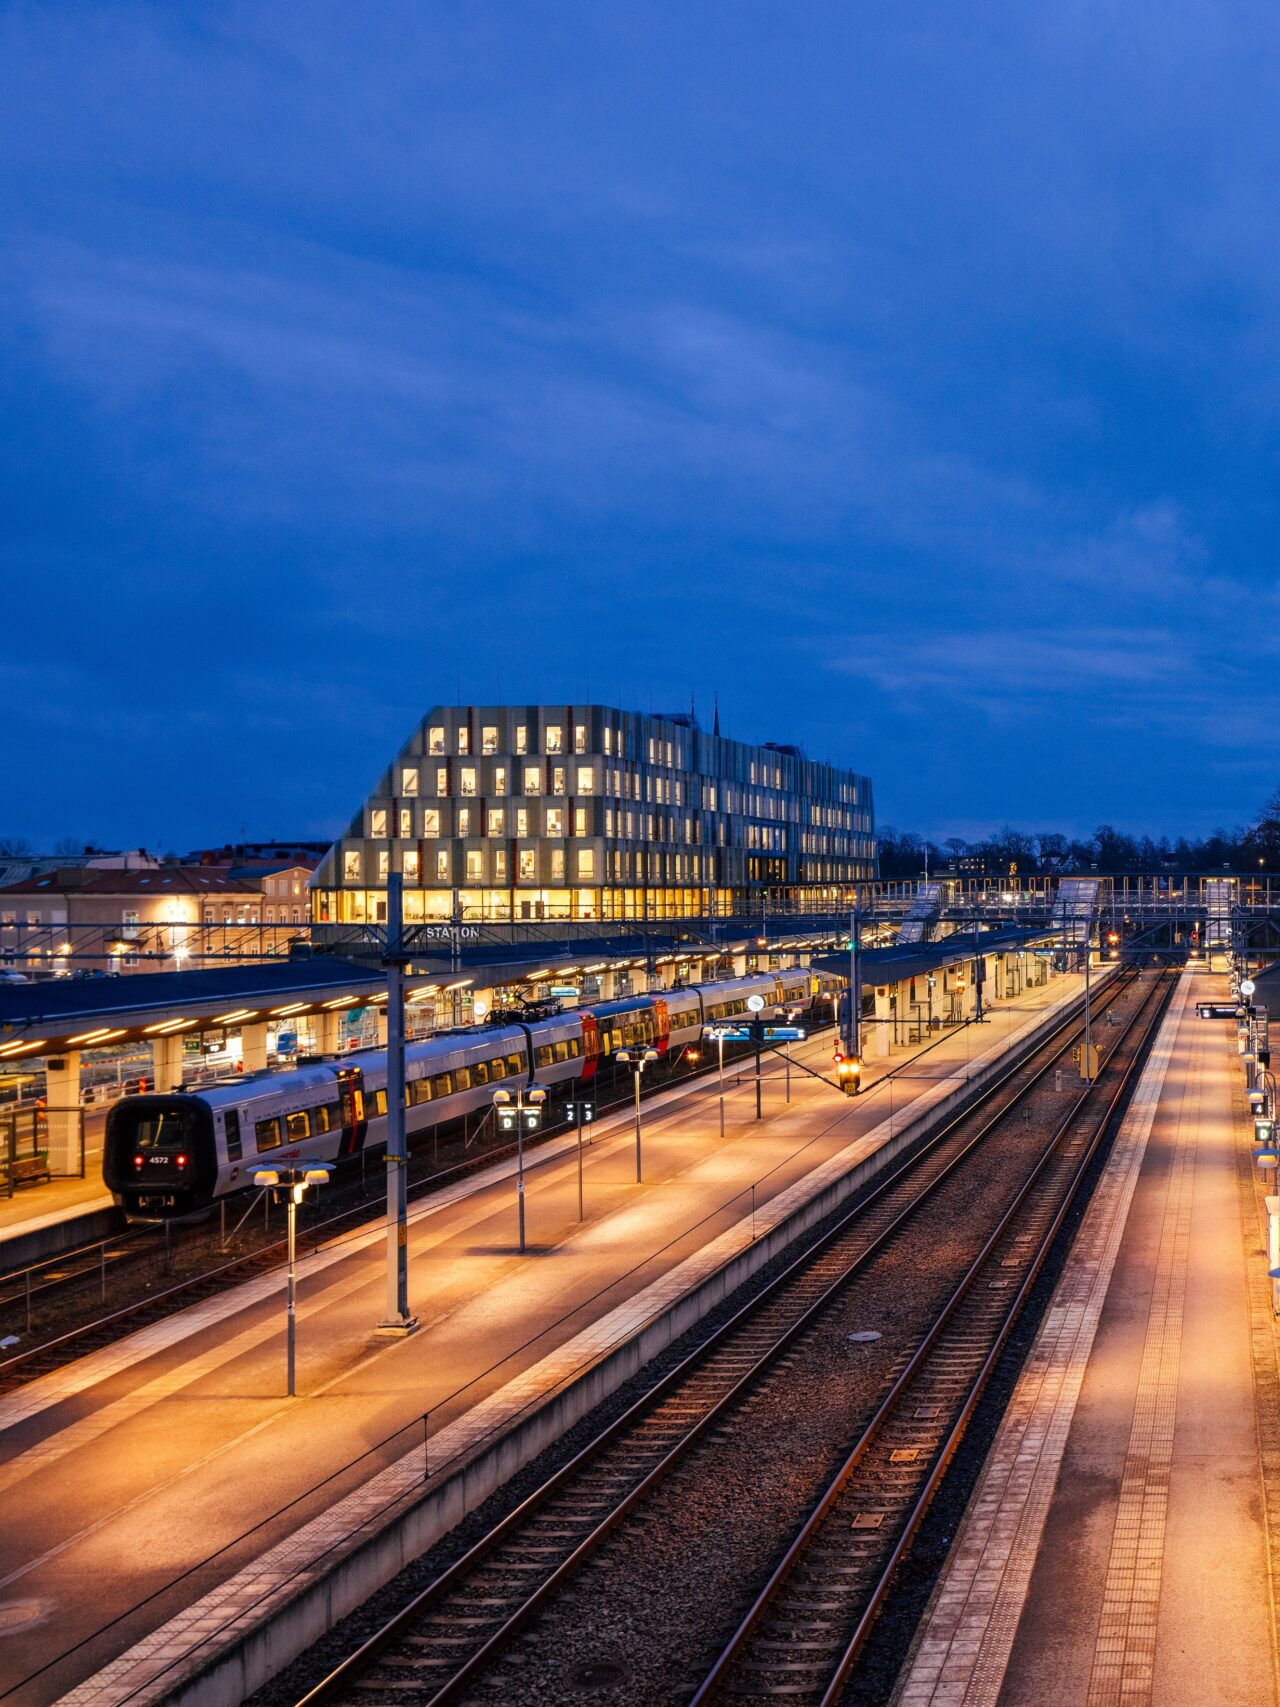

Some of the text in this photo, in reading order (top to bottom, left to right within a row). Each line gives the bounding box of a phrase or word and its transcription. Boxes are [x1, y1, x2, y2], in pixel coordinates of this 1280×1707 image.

[426, 927, 480, 938] STAON
[1255, 1104, 1262, 1113] 4
[567, 1111, 573, 1121] 2
[585, 1111, 592, 1121] 3
[503, 1117, 512, 1129] D
[528, 1117, 537, 1128] D
[1260, 1129, 1268, 1139] D
[149, 1156, 169, 1164] 4572
